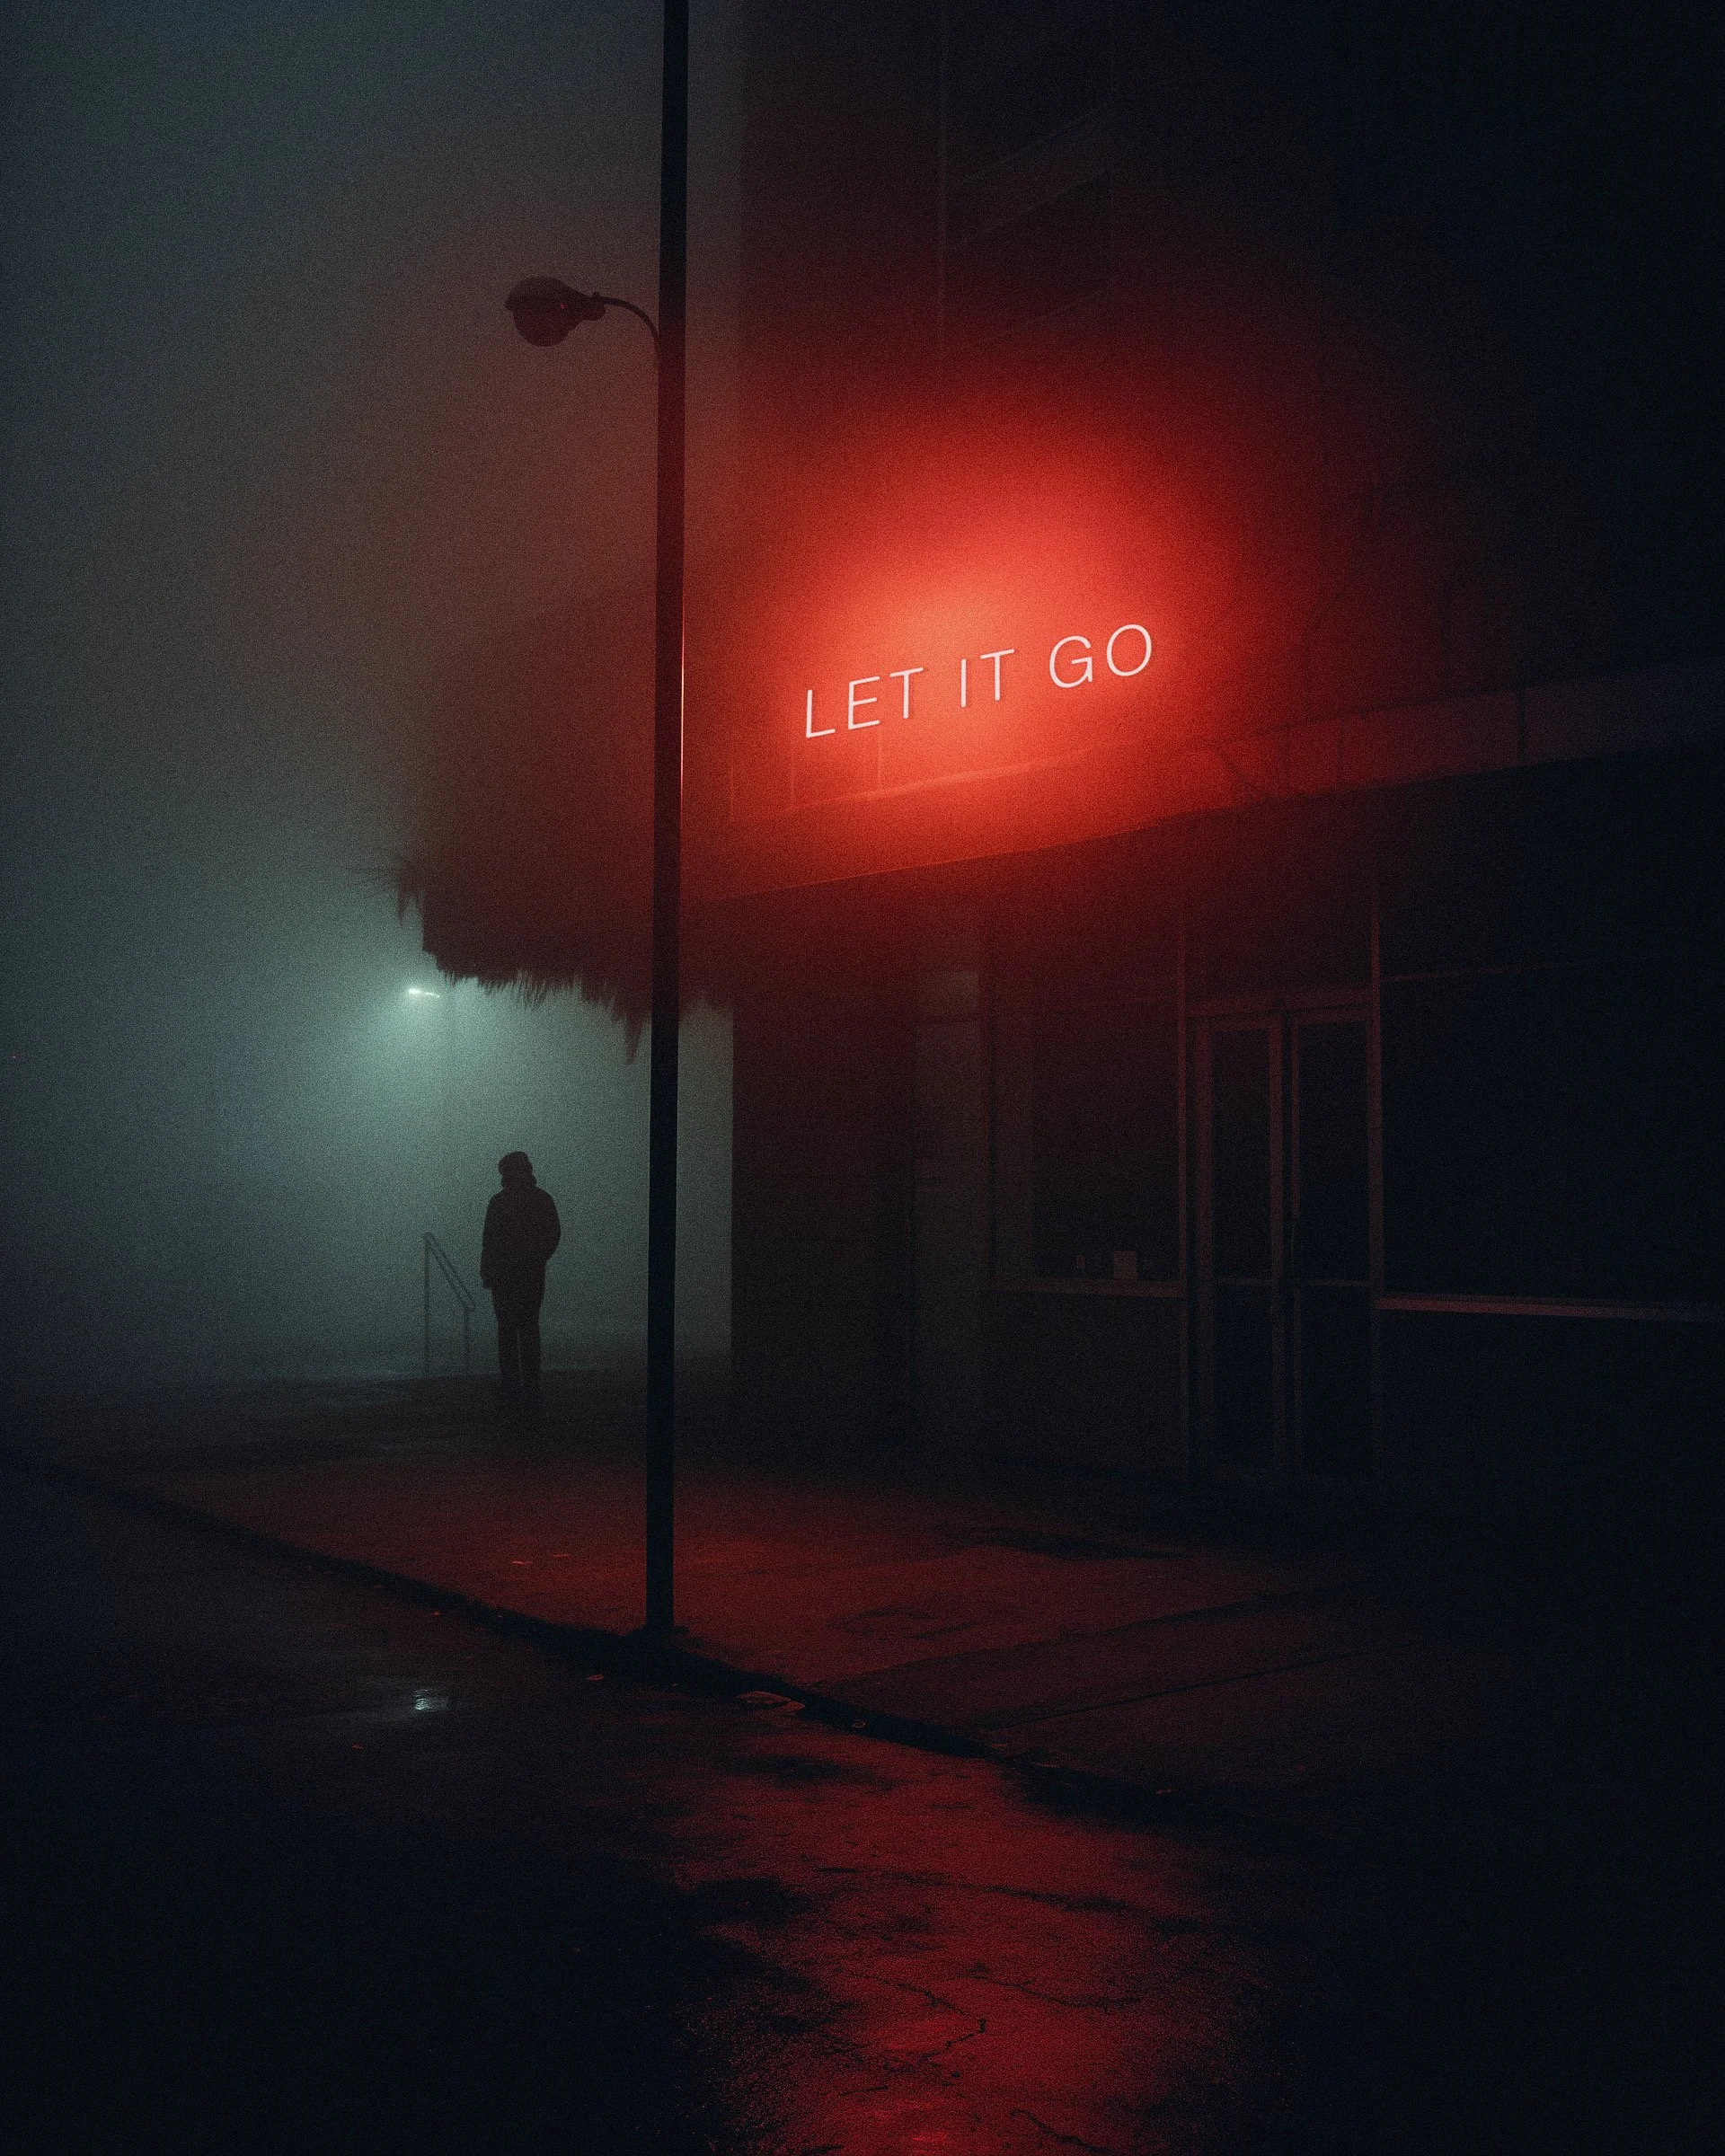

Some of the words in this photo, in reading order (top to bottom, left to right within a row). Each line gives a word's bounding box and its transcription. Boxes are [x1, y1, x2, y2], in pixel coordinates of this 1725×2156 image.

[806, 667, 924, 738] LET
[960, 649, 1015, 708] IT
[1049, 624, 1152, 688] GO
